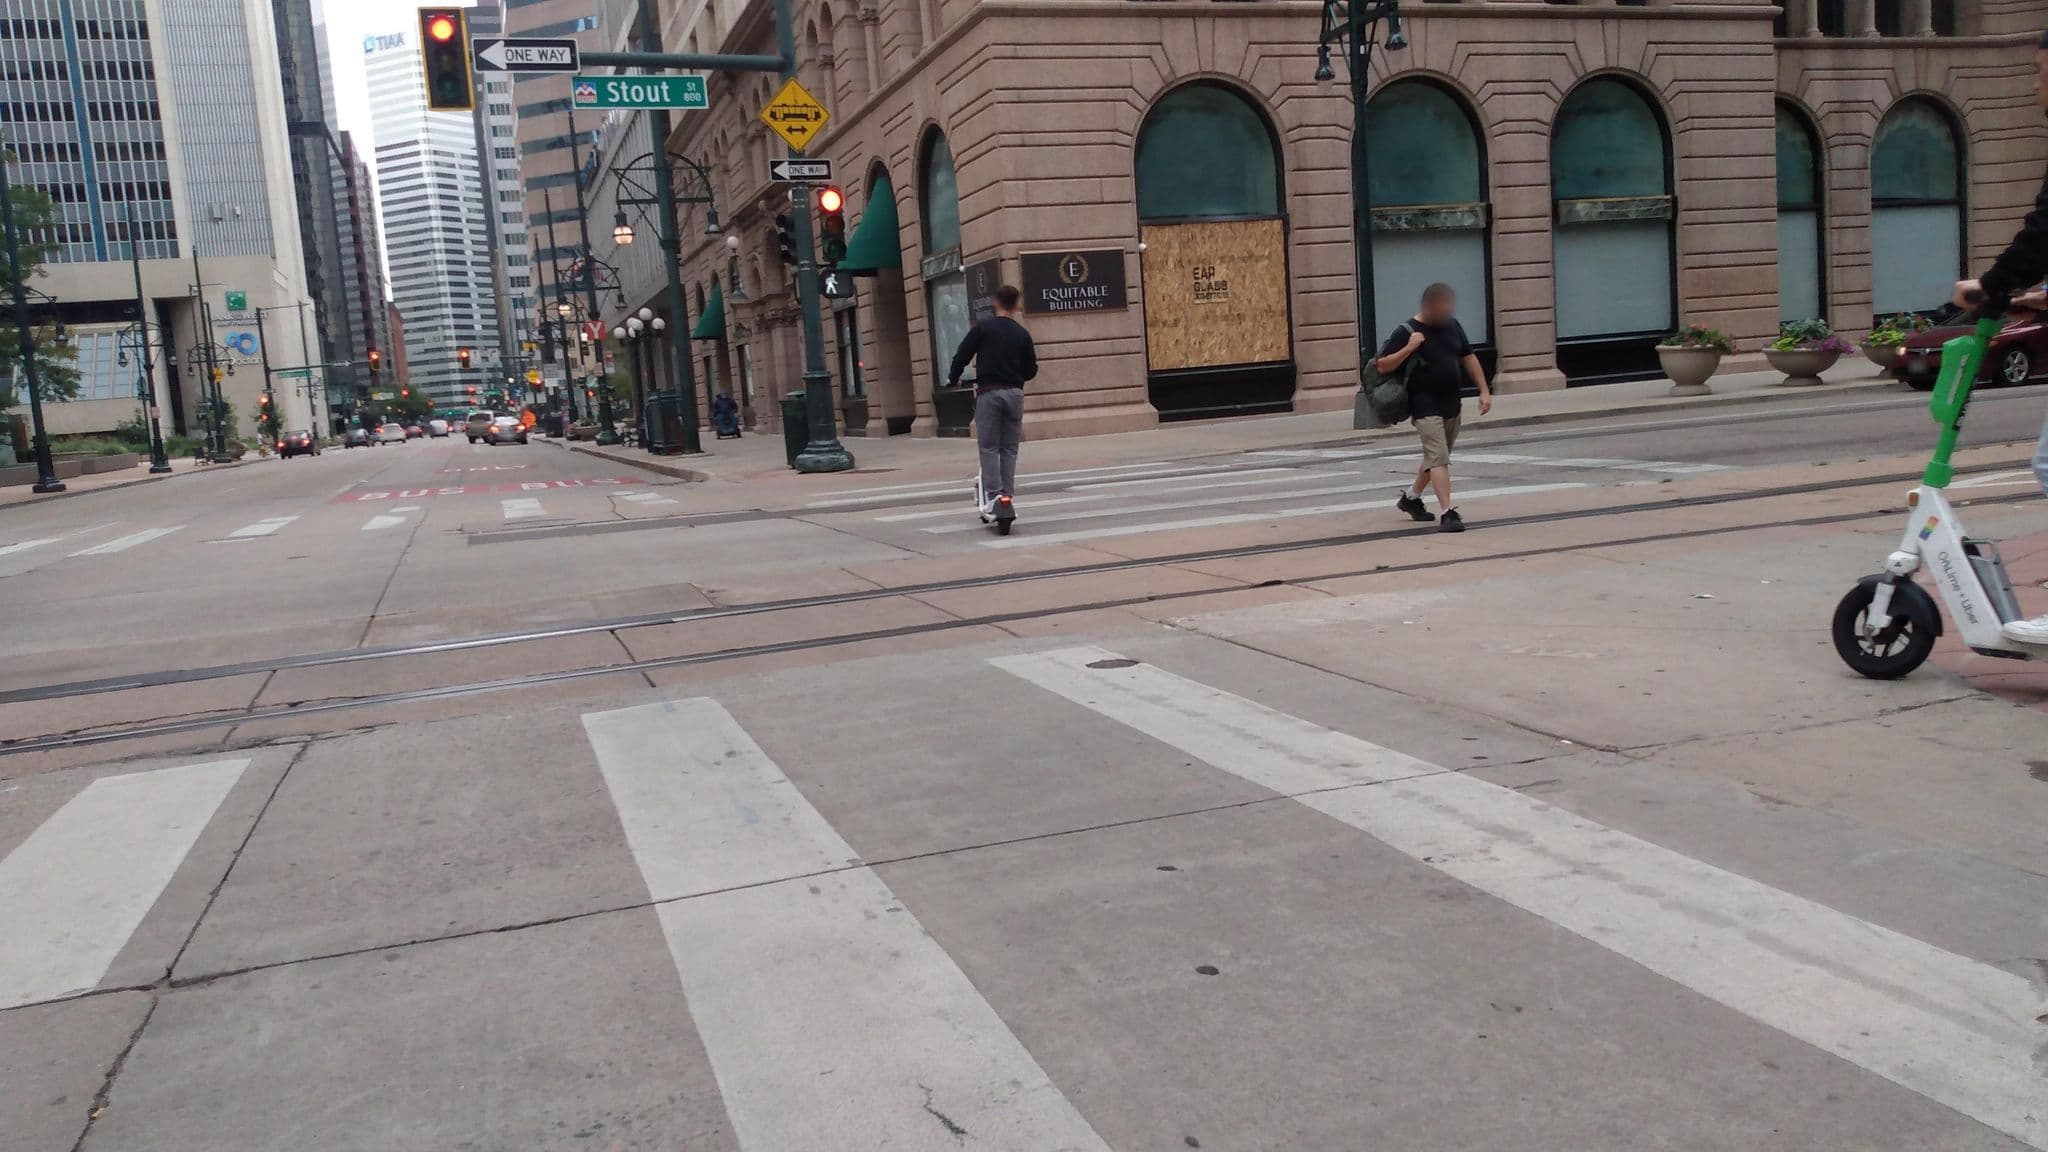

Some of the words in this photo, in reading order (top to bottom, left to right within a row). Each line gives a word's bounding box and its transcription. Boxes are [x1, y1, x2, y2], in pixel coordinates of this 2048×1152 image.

[505, 48, 534, 62] ONE
[539, 48, 567, 62] WAY
[607, 81, 671, 103] Stout
[687, 82, 697, 91] St
[683, 92, 702, 102] 800
[788, 166, 806, 175] ONE
[808, 166, 825, 175] WAY
[1069, 262, 1080, 277] E
[1193, 266, 1215, 280] EAP
[1042, 285, 1109, 301] EQUITABLE
[1049, 299, 1103, 311] BUILDING
[588, 321, 602, 340] Y
[357, 487, 465, 501] BUS
